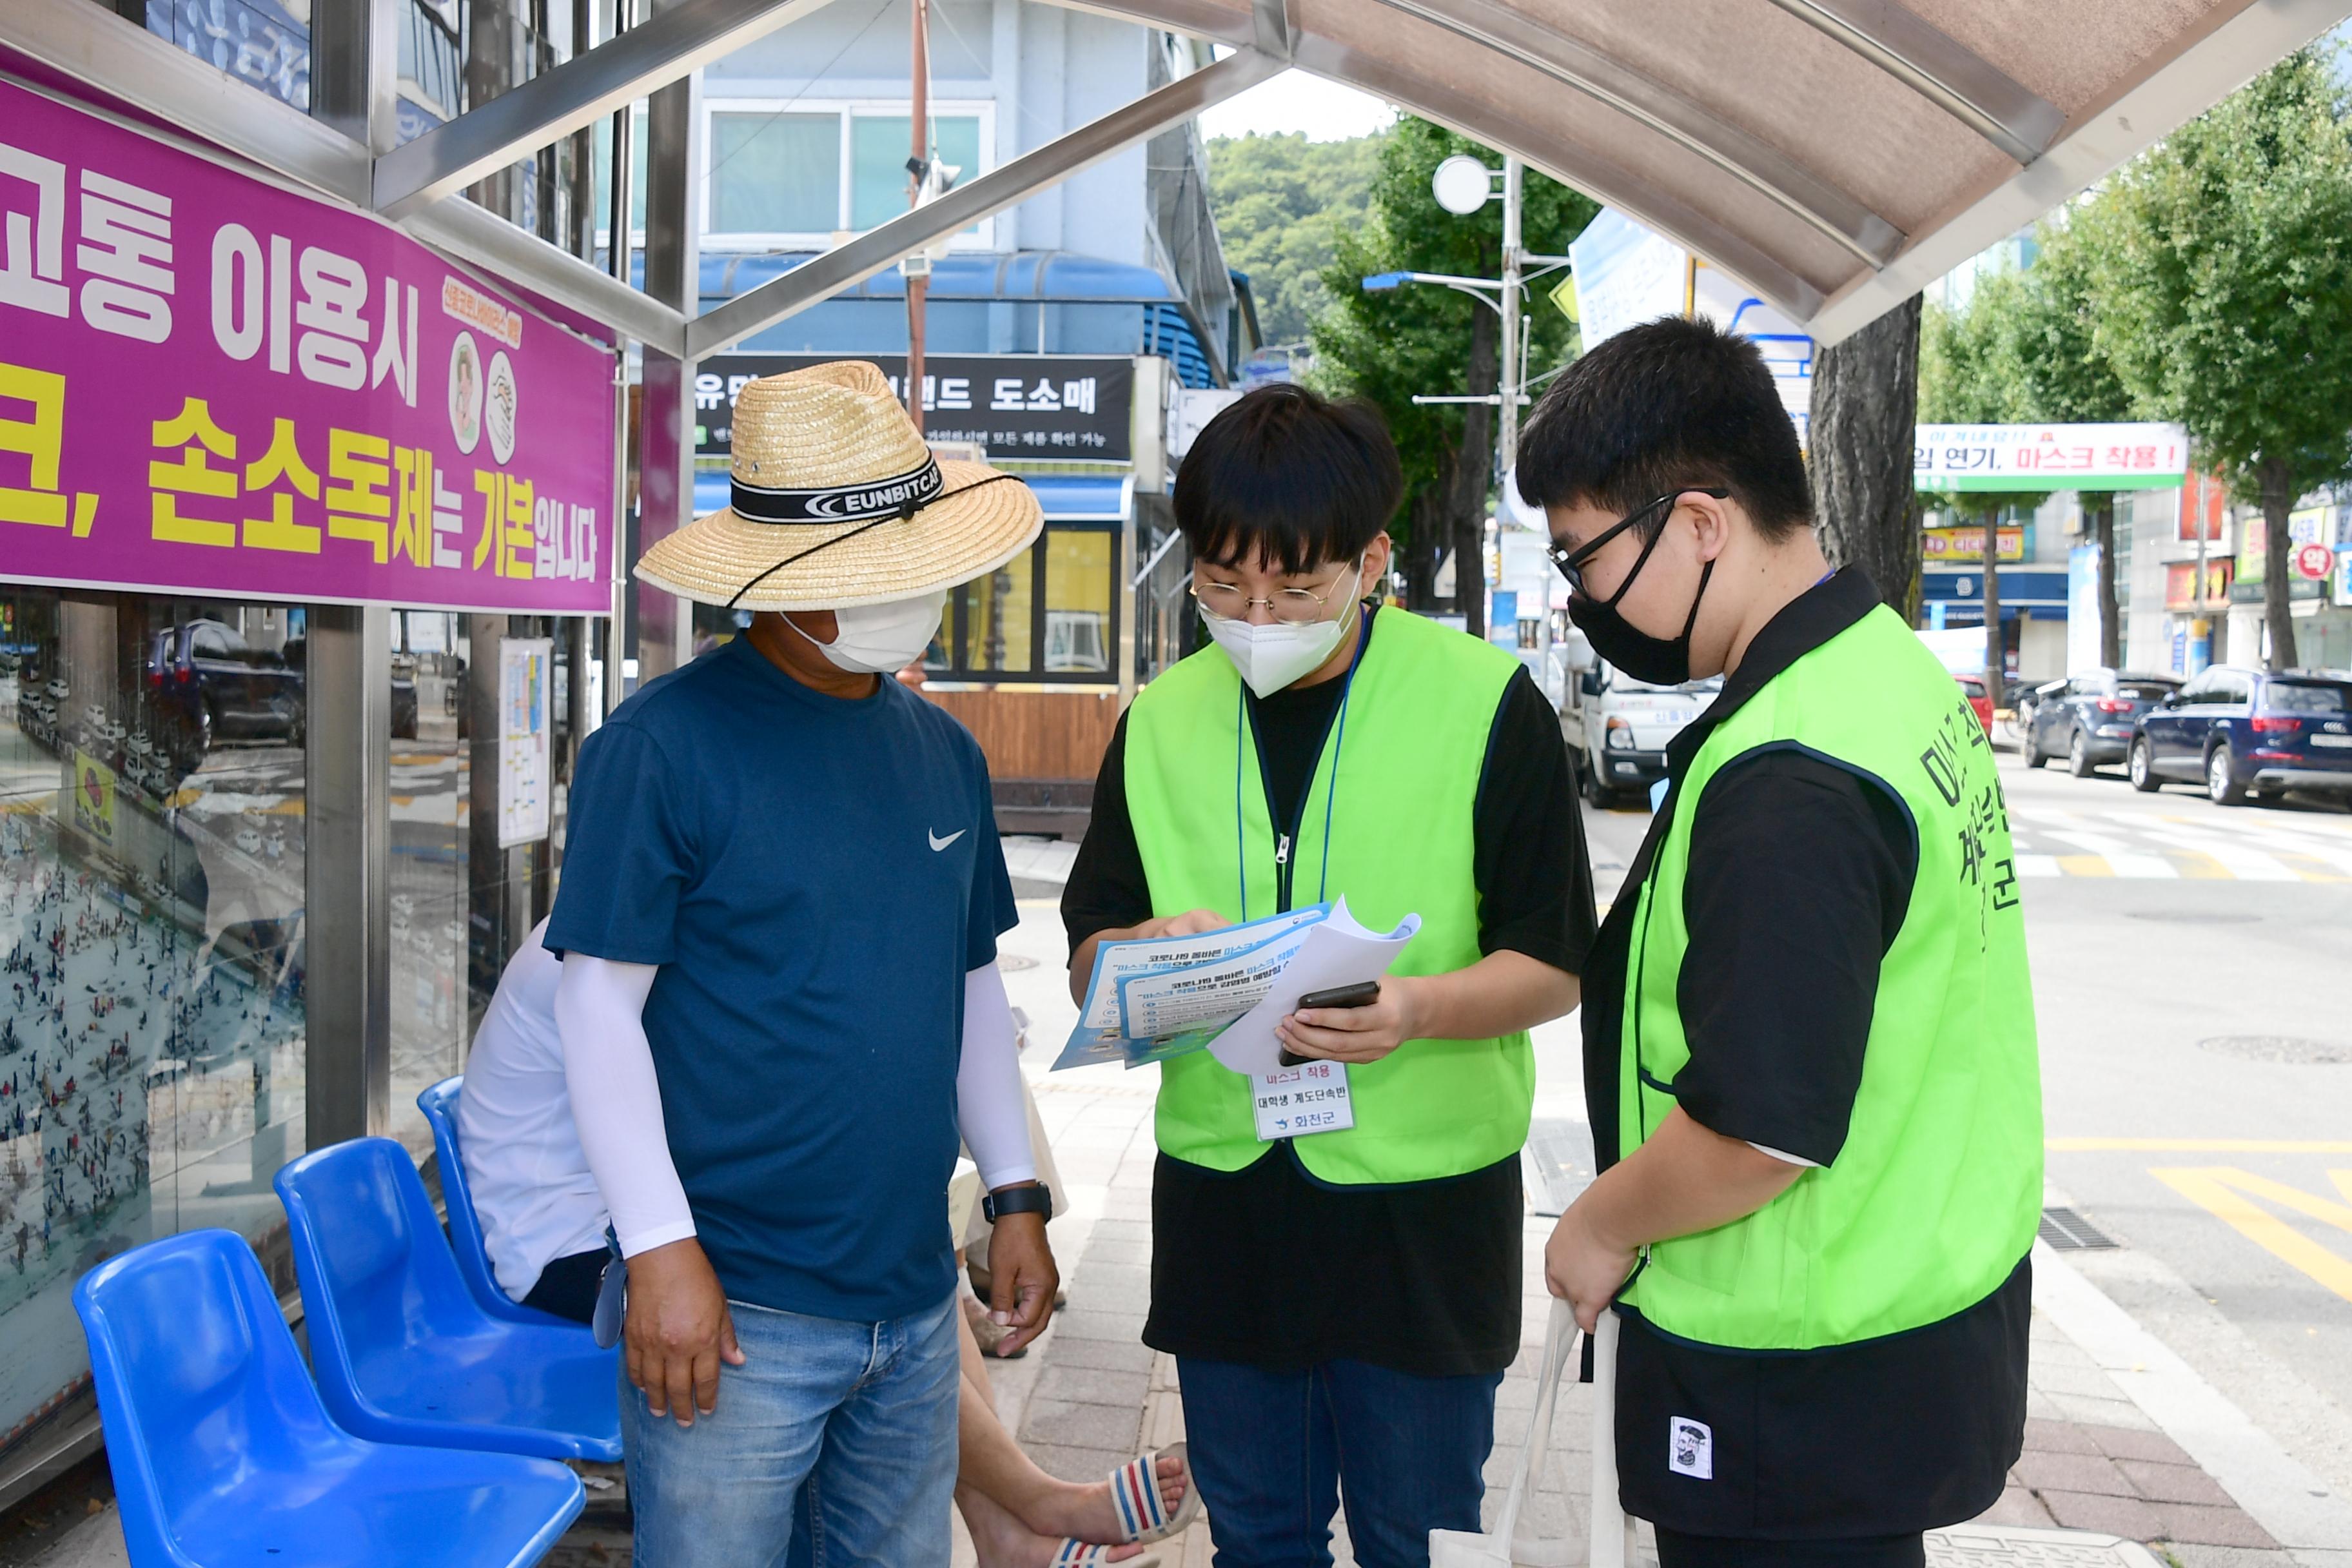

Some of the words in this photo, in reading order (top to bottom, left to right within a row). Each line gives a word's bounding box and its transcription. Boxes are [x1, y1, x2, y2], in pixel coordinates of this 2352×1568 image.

[0, 142, 175, 344] 교통
[211, 222, 418, 408] 이용시
[990, 377, 1096, 415] 도소매
[1945, 447, 2001, 470] 연기,
[2016, 446, 2095, 469] 마스크
[0, 362, 100, 538] 크,
[148, 396, 462, 569] 손소독제는
[473, 469, 598, 583] 기본입니다
[844, 466, 939, 512] EUNBITCAP
[2302, 548, 2327, 574] 약
[1148, 951, 1190, 963] 코로나19
[1224, 943, 1253, 956] 마스크
[1171, 976, 1211, 989] 코로나19
[1246, 959, 1275, 974] 마스크
[1258, 1094, 1289, 1108] 대학생
[1294, 1086, 1346, 1104] 계도단속반
[1295, 1111, 1335, 1128] 화천군
